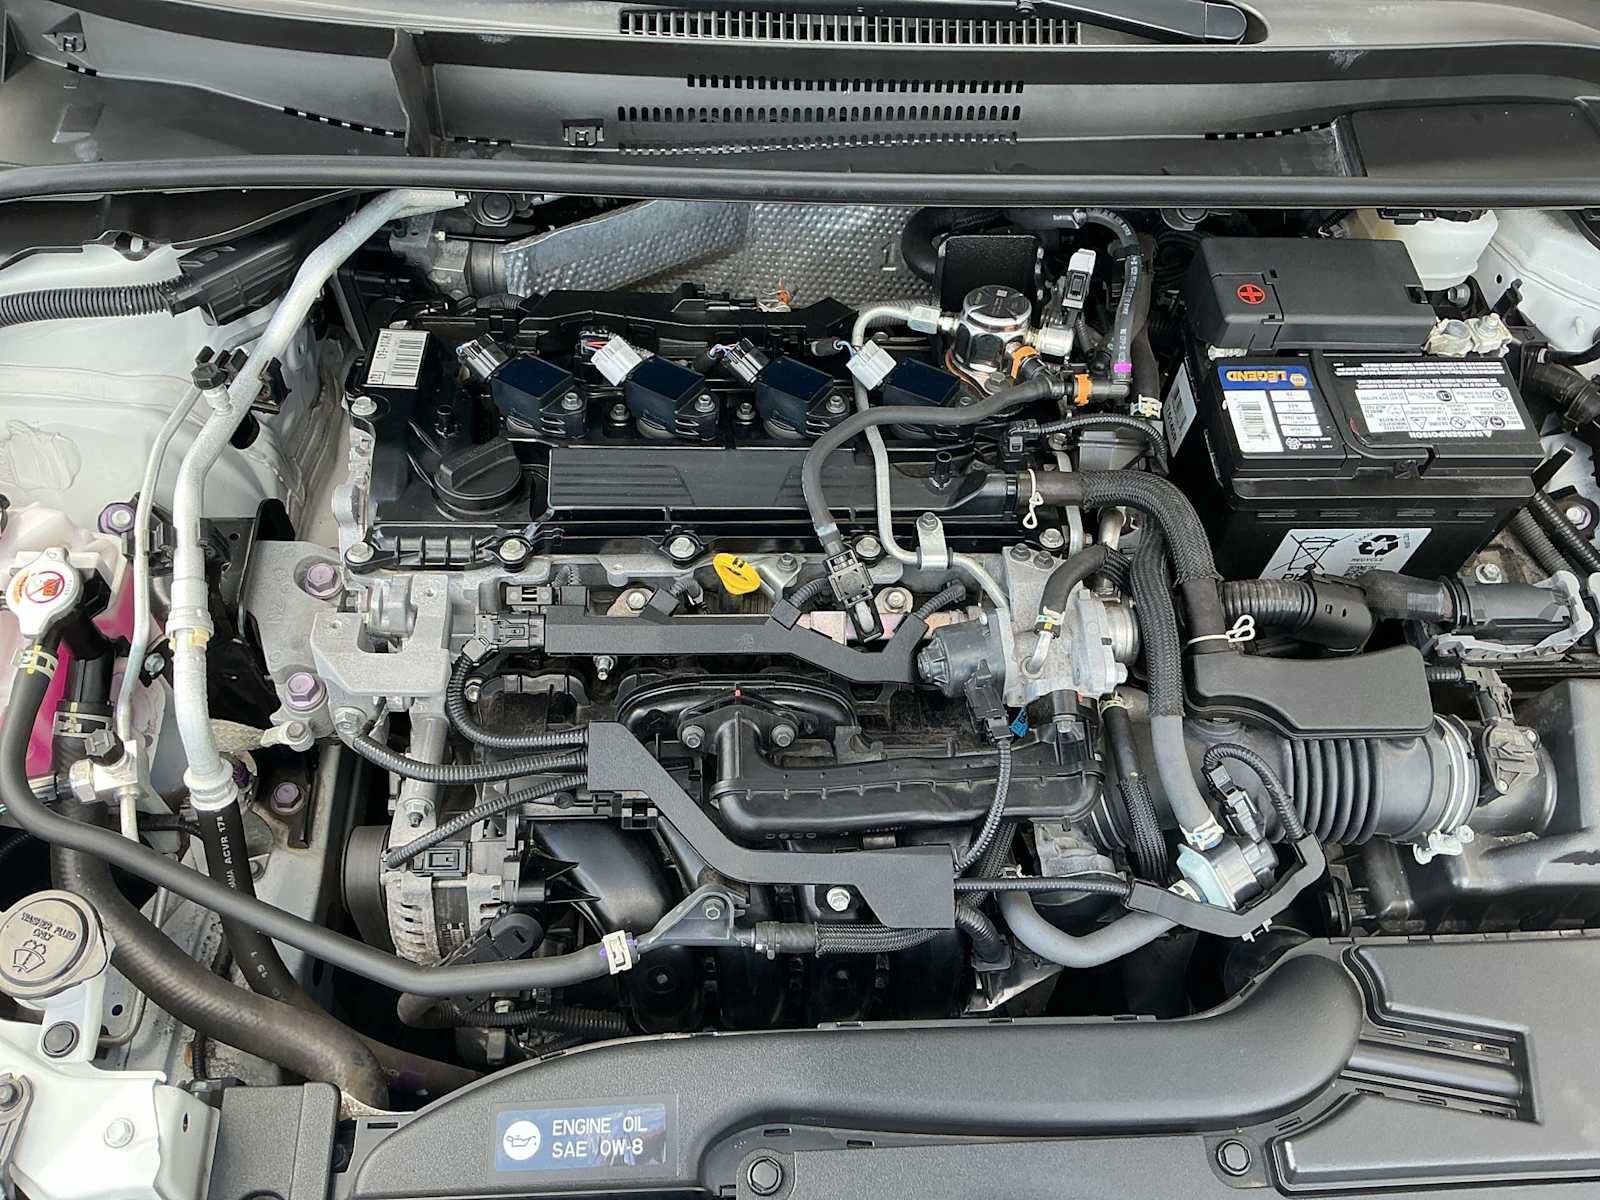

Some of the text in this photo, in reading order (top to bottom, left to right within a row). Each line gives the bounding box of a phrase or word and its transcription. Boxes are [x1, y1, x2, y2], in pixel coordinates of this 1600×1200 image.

[1226, 370, 1288, 382] LEGEND
[1408, 431, 1484, 439] DANGER/POISON
[220, 835, 233, 865] ACVR
[552, 1115, 648, 1136] ENGINE OIL
[552, 1138, 643, 1158] SAE 0W-8
